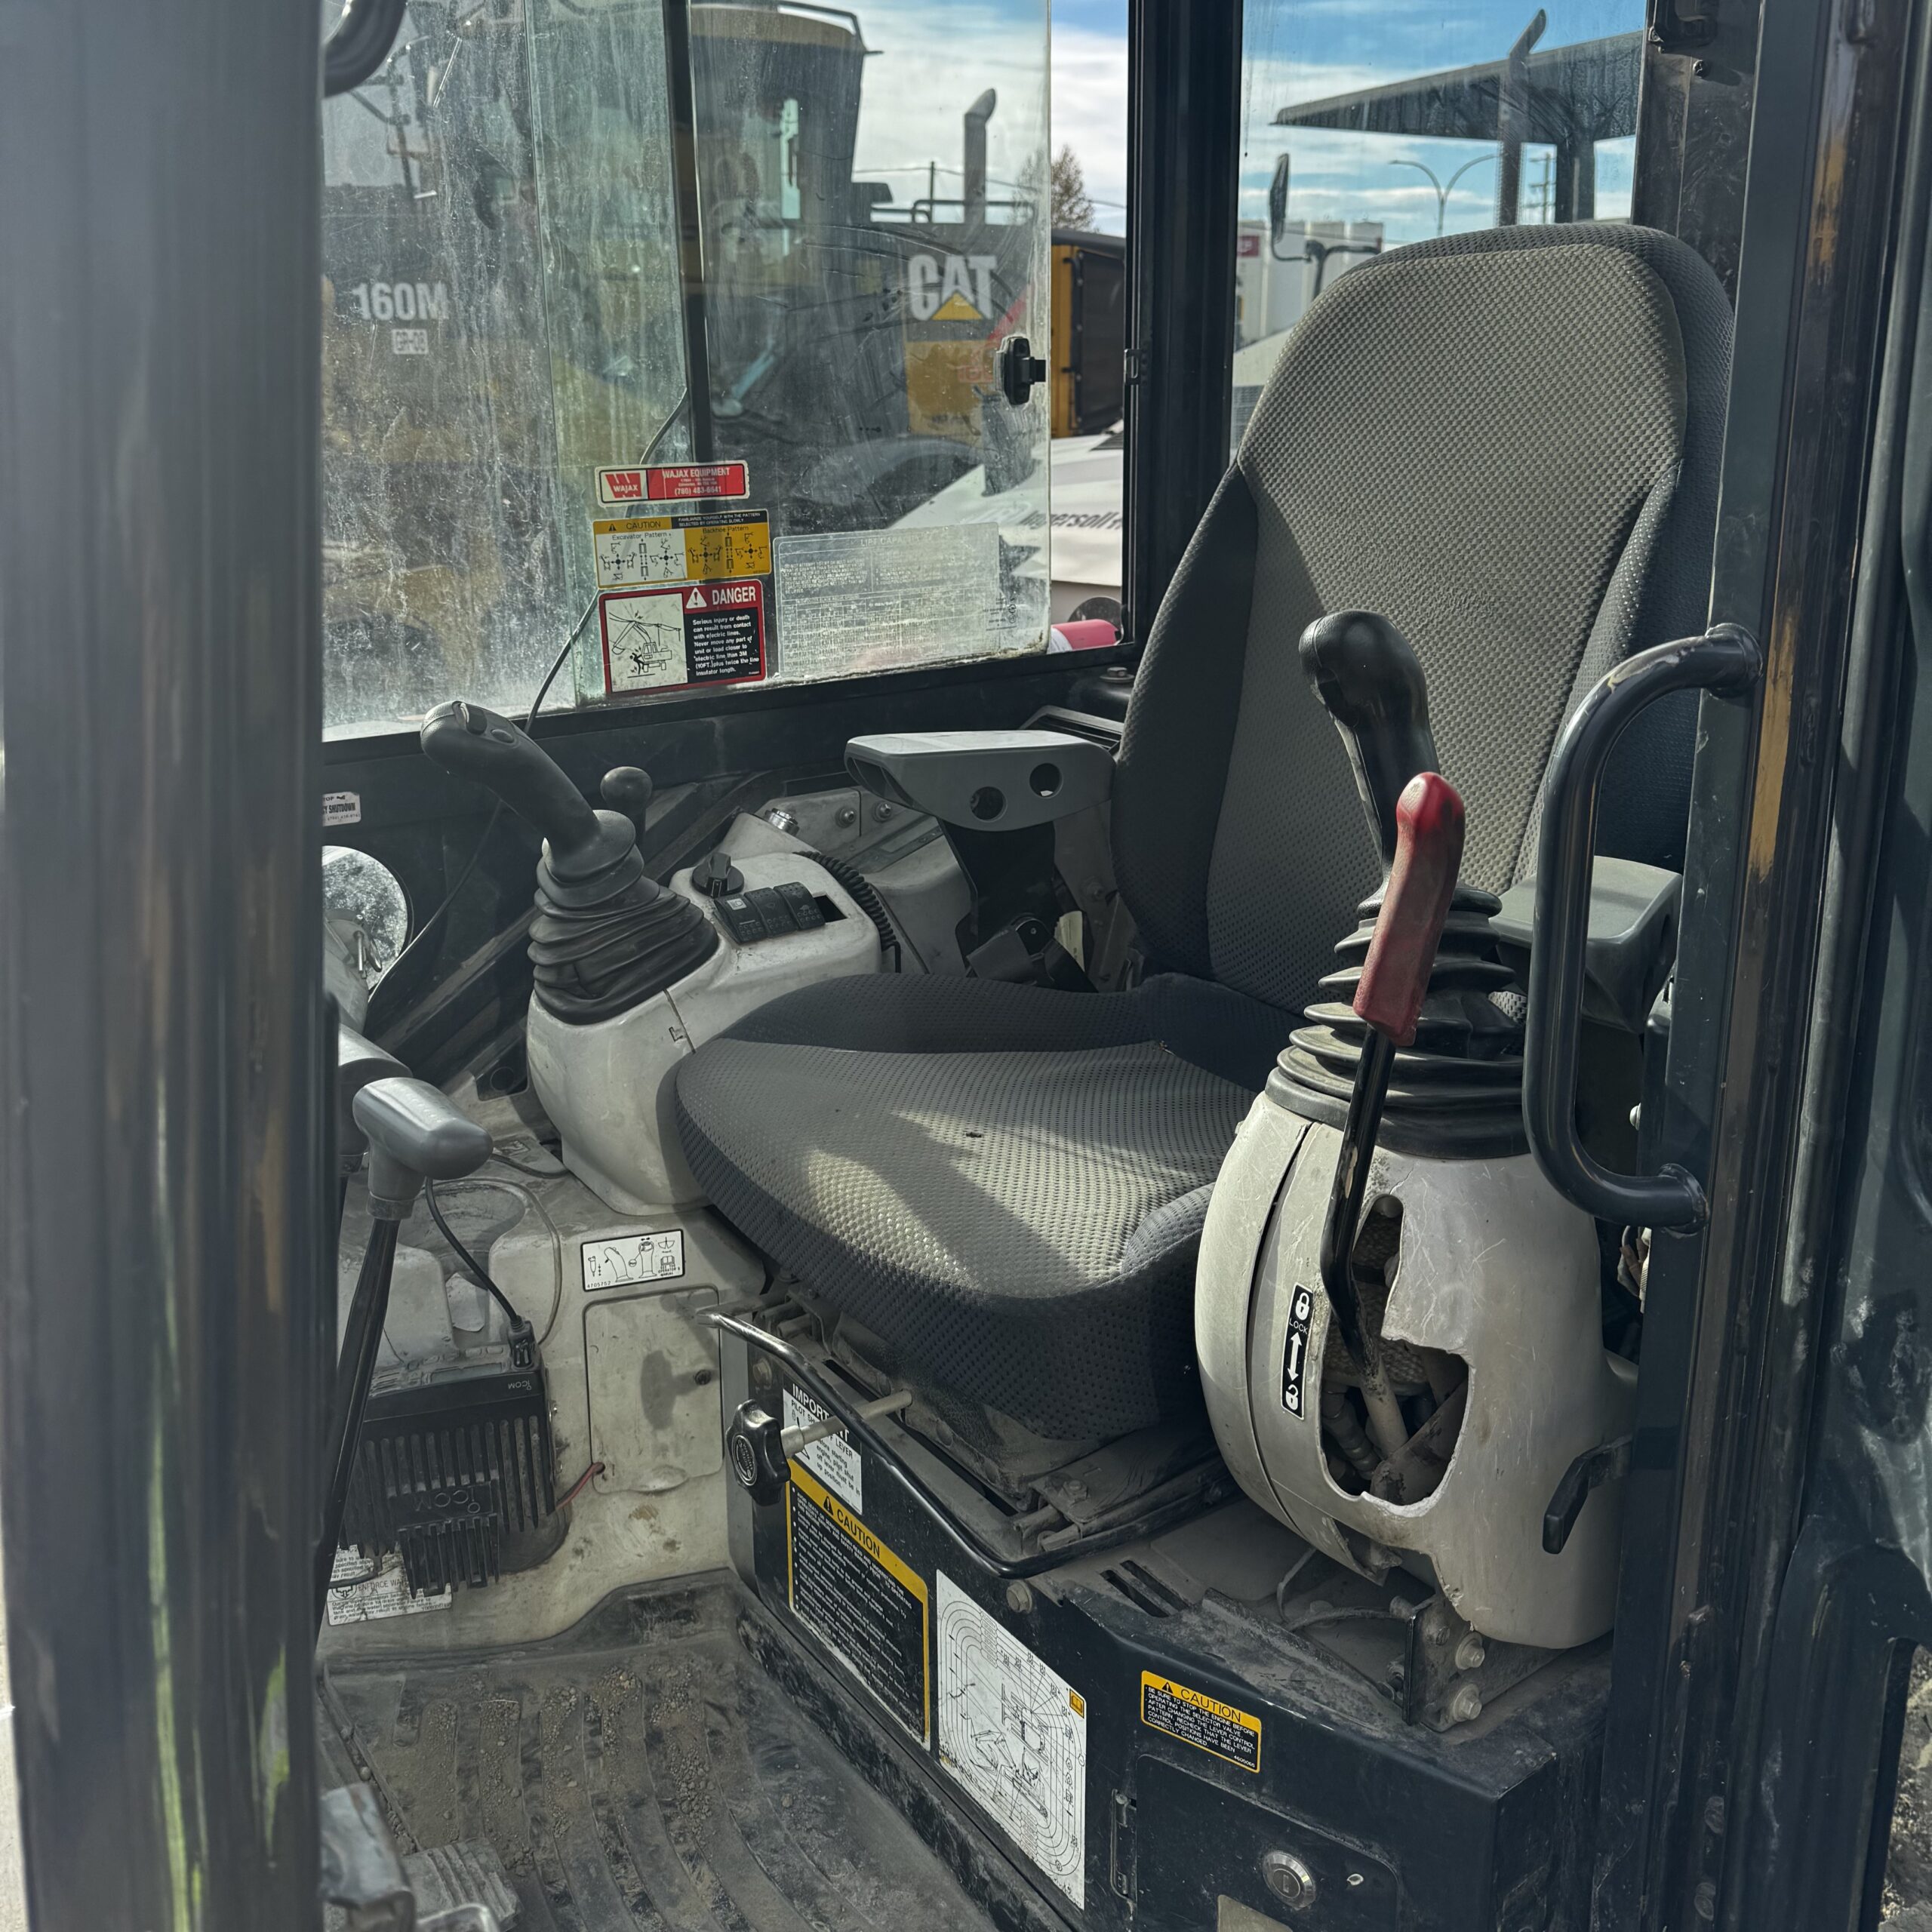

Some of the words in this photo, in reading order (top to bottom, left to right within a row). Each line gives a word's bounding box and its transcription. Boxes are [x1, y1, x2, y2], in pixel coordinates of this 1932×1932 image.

[352, 282, 448, 320] 160M
[908, 254, 998, 320] CAT
[614, 485, 638, 493] WAJAX
[663, 469, 688, 478] WAJAX
[691, 468, 730, 477] EQUIPMENT
[626, 521, 661, 530] CAUTION
[712, 586, 756, 605] DANGER
[329, 802, 355, 814] SHUTDOWN
[1289, 1318, 1308, 1334] LOCK
[792, 1400, 805, 1418] PILOT
[835, 1438, 853, 1459] LEVER
[837, 1509, 880, 1558] CAUTION
[358, 1581, 388, 1591] ENFORCE
[1148, 1694, 1178, 1709] OPERATING
[1180, 1706, 1190, 1715] THE
[1192, 1710, 1220, 1727] SELECTOR
[1158, 1690, 1171, 1700] SURE
[1183, 1700, 1197, 1711] STOP
[1199, 1707, 1209, 1716] THE
[1211, 1713, 1231, 1726] ENGINE
[1233, 1722, 1255, 1737] BEFORE
[1181, 1689, 1241, 1723] CAUTION
[1148, 1716, 1179, 1733] CORRECTLY
[1148, 1711, 1172, 1724] CONTROL
[1175, 1722, 1201, 1739] POSITIONS
[1204, 1734, 1218, 1746] HAVE
[1220, 1742, 1235, 1753] BEEN
[1149, 1700, 1166, 1709] AFTER
[1168, 1707, 1195, 1723] CHANGING
[1197, 1720, 1208, 1728] THE
[1210, 1724, 1226, 1737] LEVER
[1229, 1732, 1255, 1749] CONTROL
[1177, 1717, 1201, 1732] RECHECK
[1204, 1729, 1218, 1739] THAT
[1221, 1736, 1231, 1745] THE
[1233, 1742, 1251, 1754] LEVER
